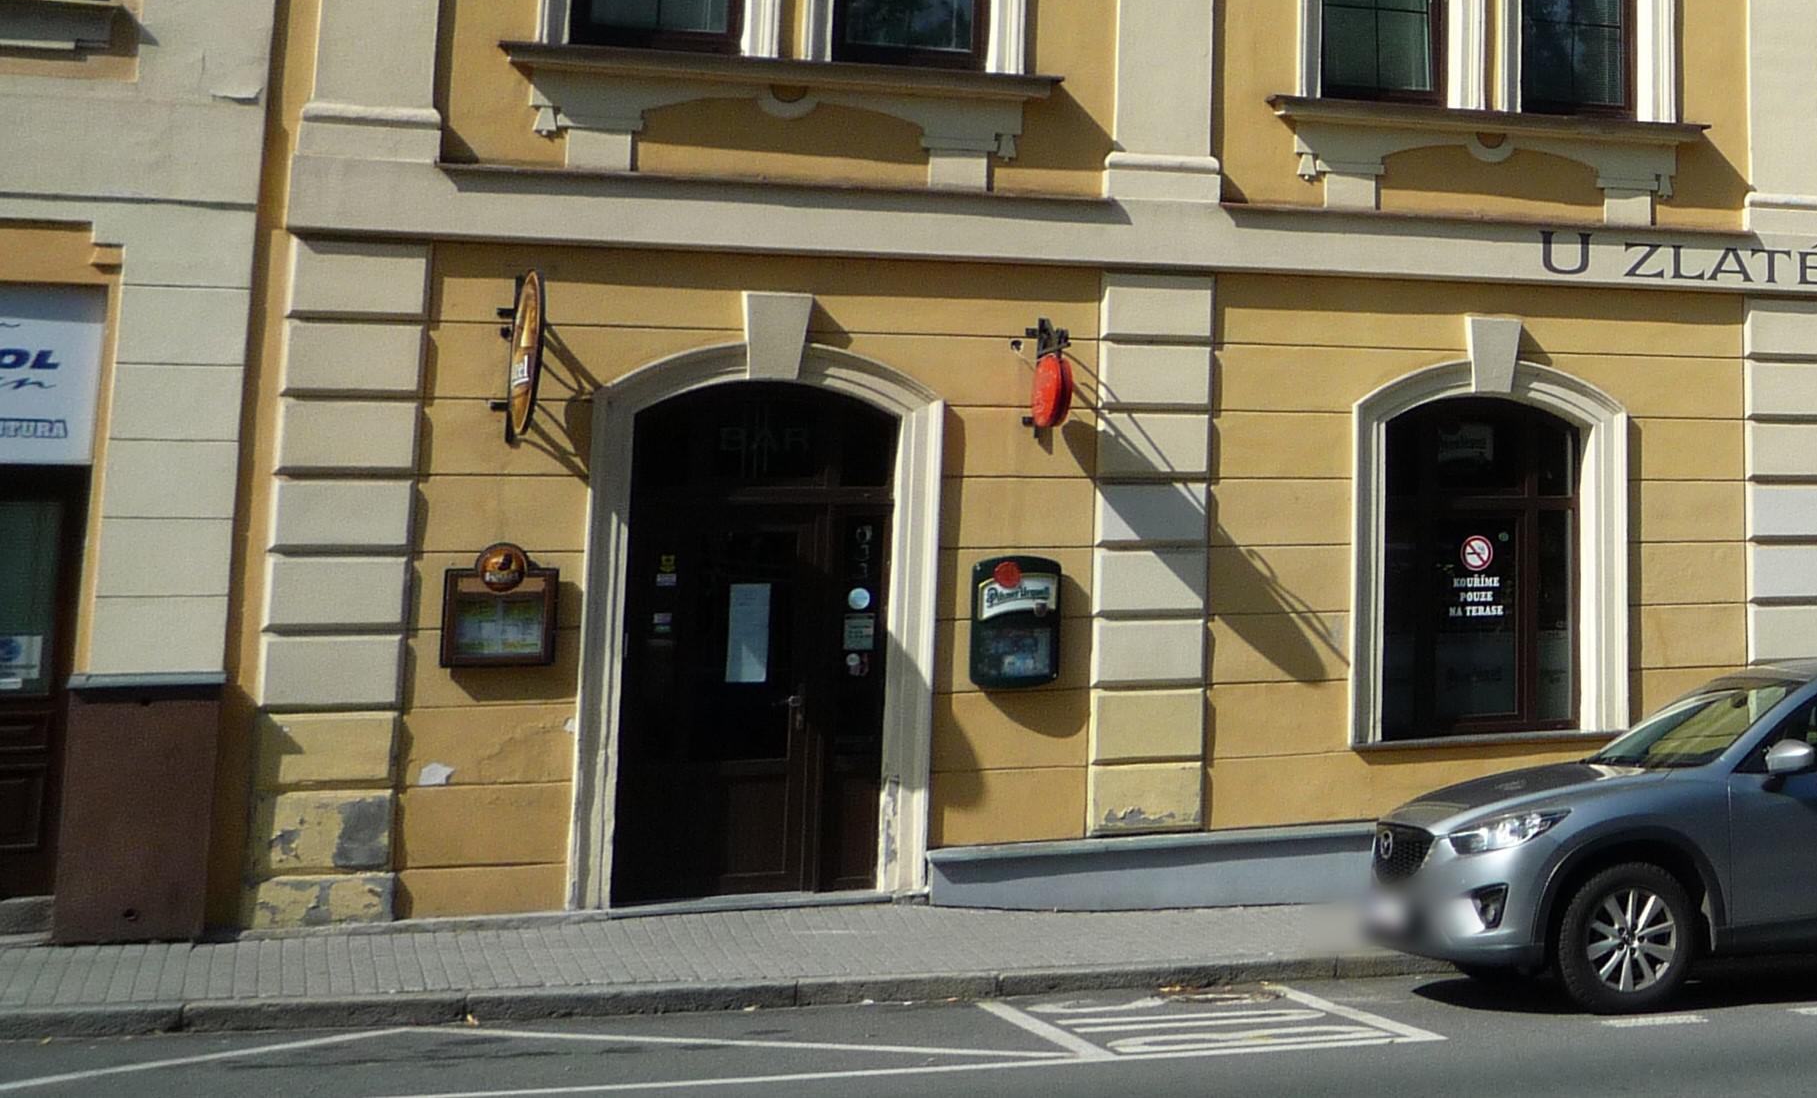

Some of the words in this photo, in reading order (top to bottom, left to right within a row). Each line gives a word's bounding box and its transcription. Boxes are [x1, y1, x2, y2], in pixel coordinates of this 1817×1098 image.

[1539, 231, 1593, 275] U
[718, 424, 811, 453] BAR
[1453, 574, 1500, 588] KOUŘÍME
[1460, 591, 1494, 602] POUZE
[1449, 606, 1463, 617] NA
[1465, 605, 1504, 617] TERASE
